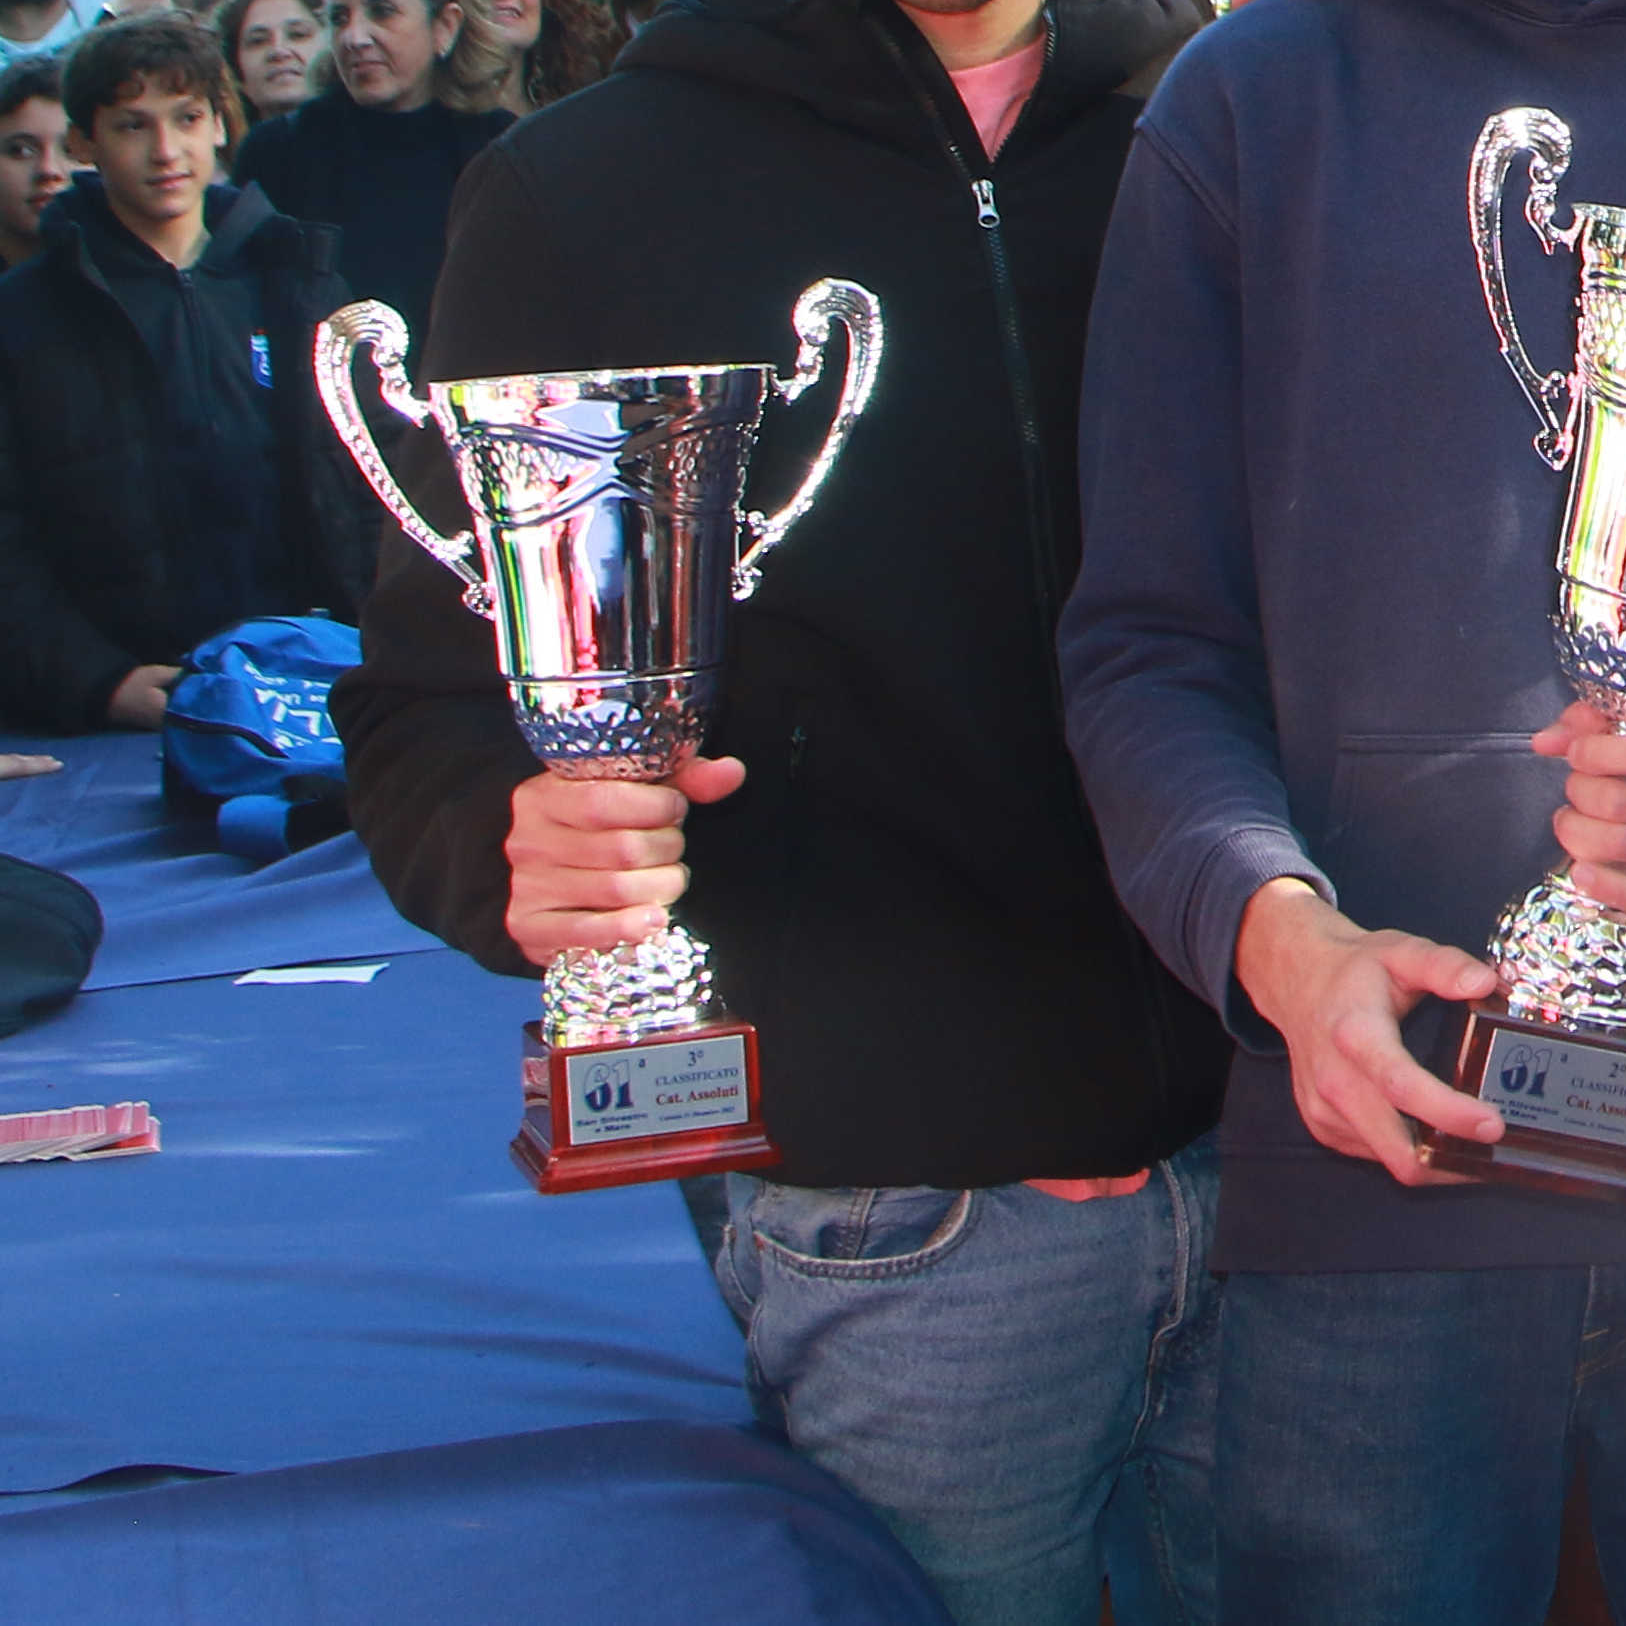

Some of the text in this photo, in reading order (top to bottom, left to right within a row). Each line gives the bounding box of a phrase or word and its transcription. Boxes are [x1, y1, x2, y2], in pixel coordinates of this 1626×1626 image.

[655, 1067, 739, 1087] CLASSIFICATO
[1501, 1044, 1552, 1097] 61
[584, 1058, 634, 1113] 61
[655, 1085, 739, 1106] Cat. Assoluti
[1566, 1095, 1588, 1111] Cat.
